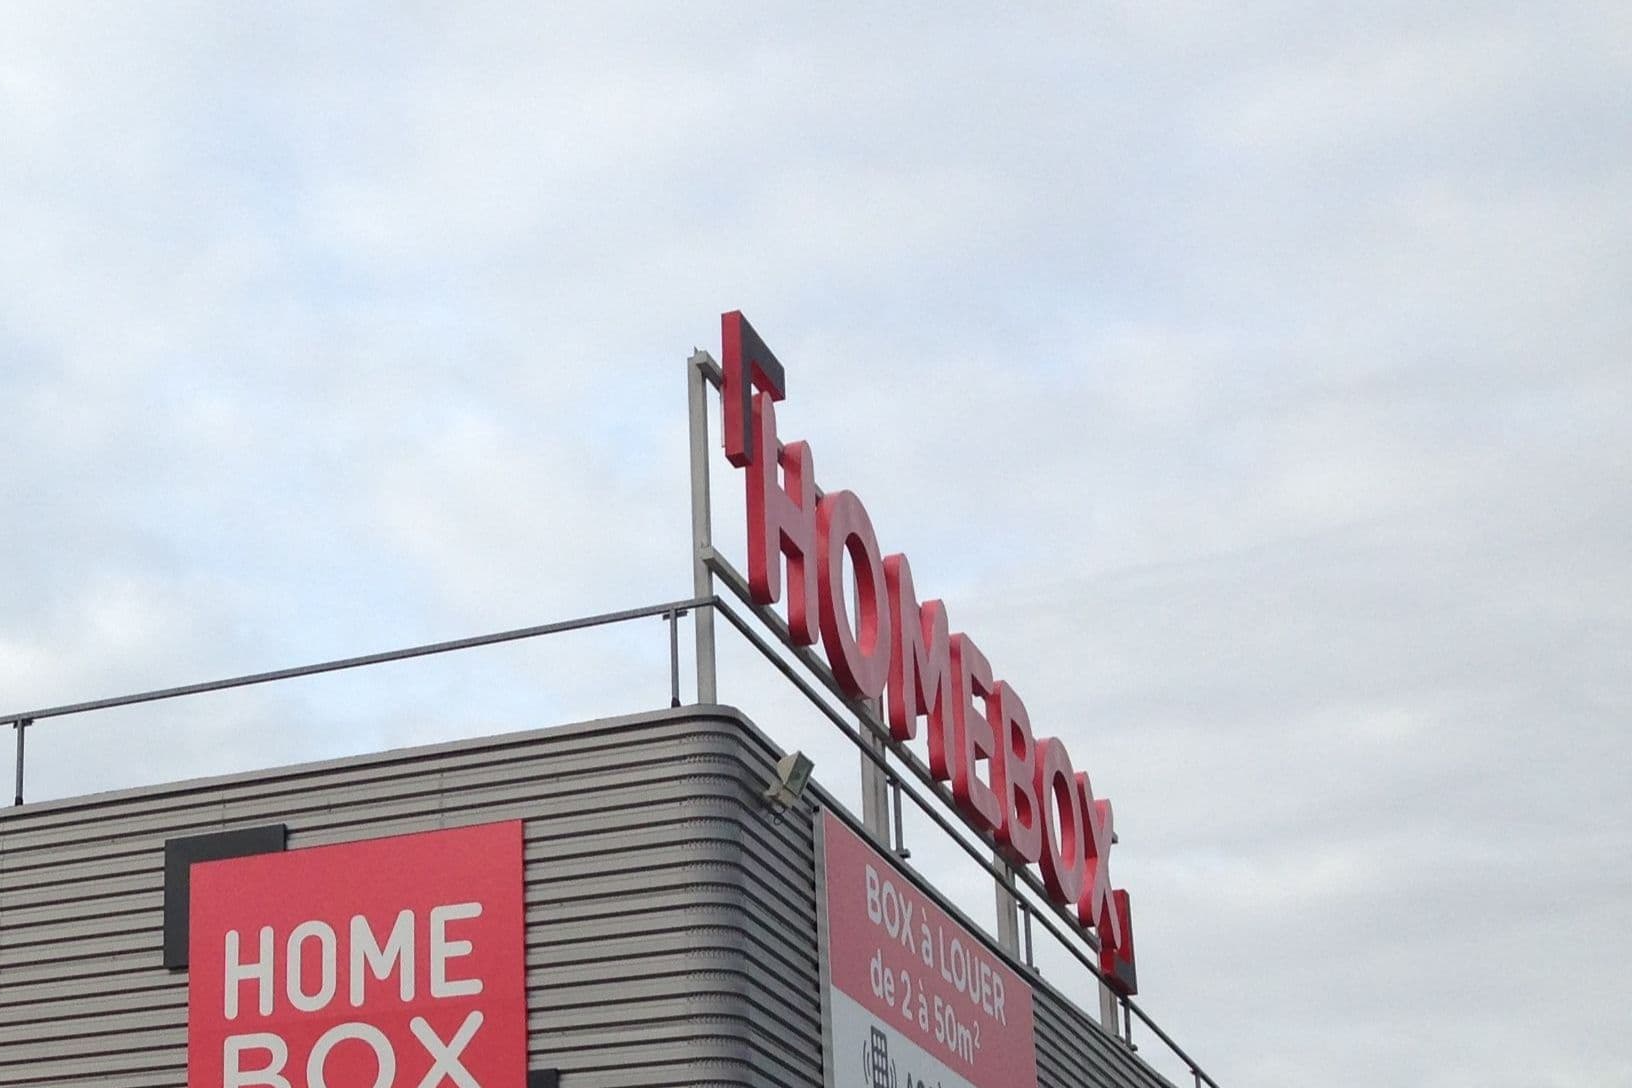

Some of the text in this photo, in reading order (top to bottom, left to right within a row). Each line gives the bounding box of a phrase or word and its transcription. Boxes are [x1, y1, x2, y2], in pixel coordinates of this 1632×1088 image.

[745, 390, 1121, 949] HOMEBOX
[223, 902, 484, 1020] HOME
[866, 863, 1007, 1026] BOX à LOUER
[870, 948, 895, 1007] de
[900, 969, 913, 1021] 2
[918, 978, 929, 1033] à
